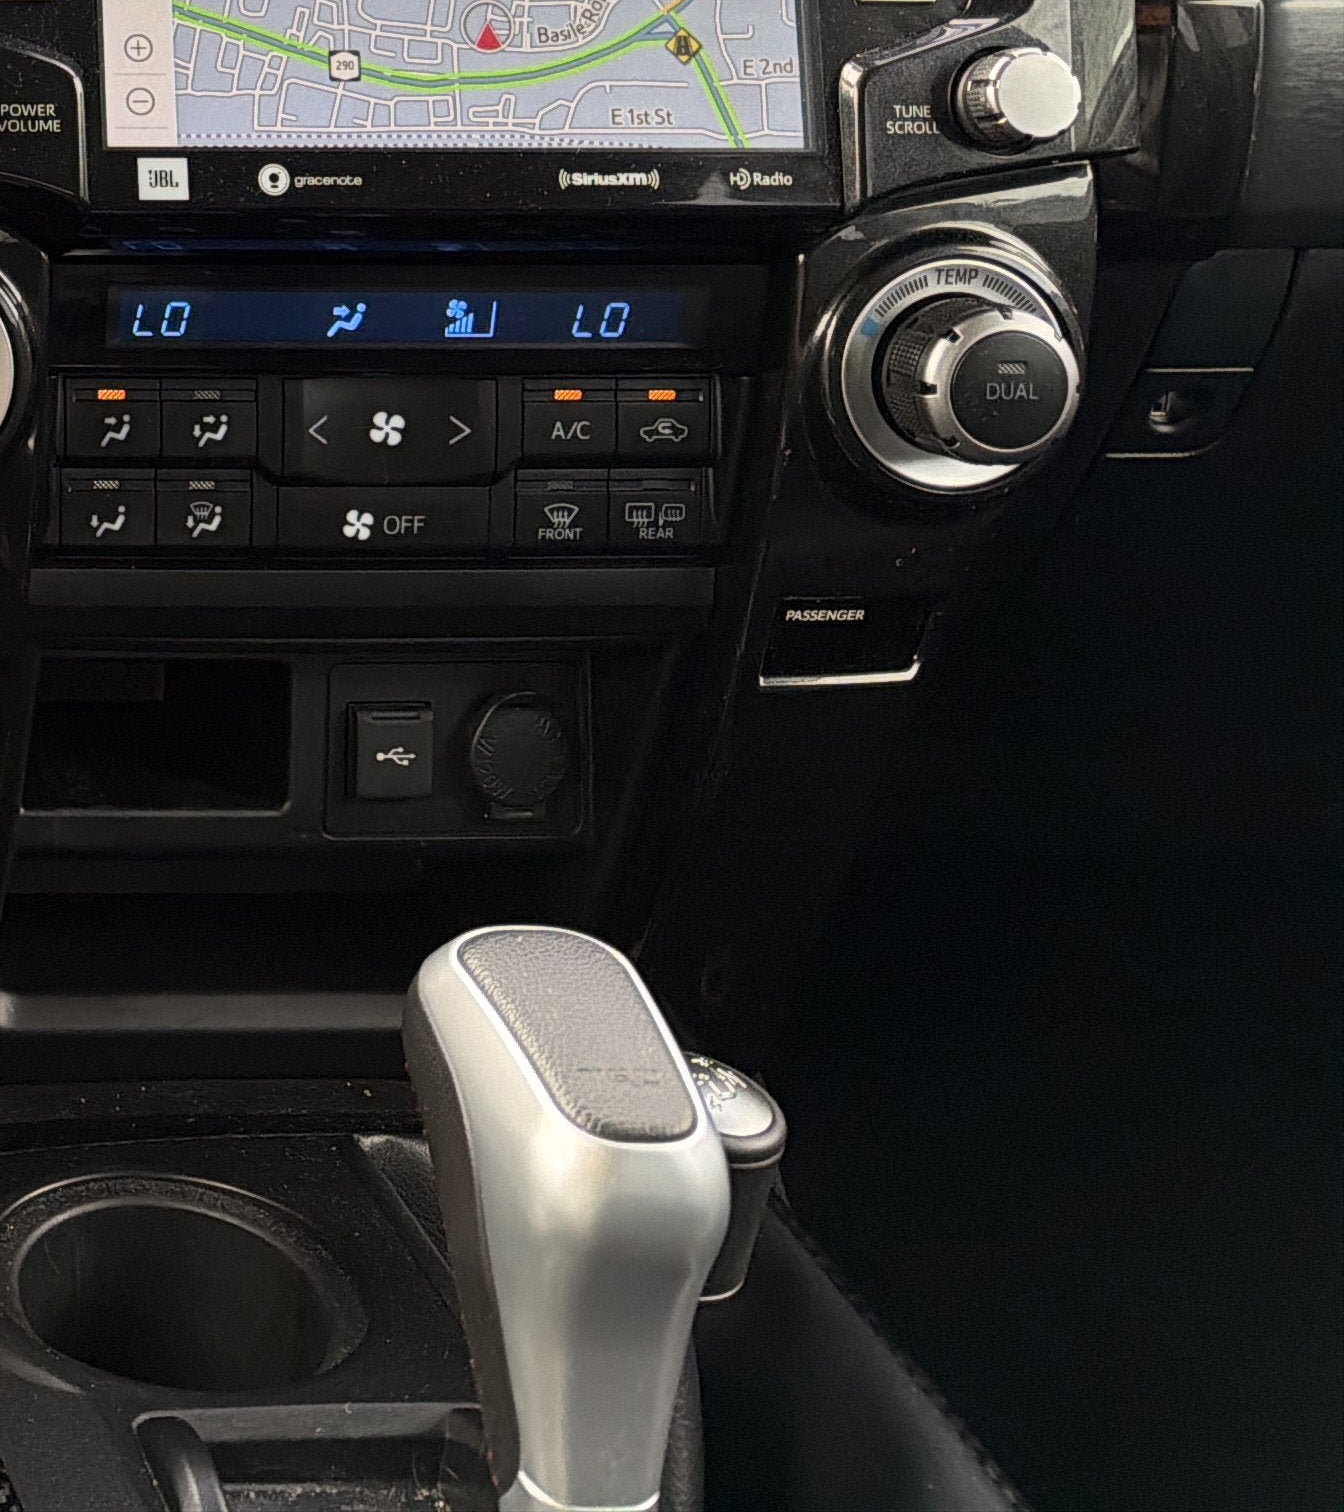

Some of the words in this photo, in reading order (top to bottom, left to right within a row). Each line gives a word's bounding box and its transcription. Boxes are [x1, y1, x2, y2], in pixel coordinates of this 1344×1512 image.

[335, 58, 355, 72] 290
[743, 58, 753, 75] E
[759, 56, 794, 76] 2nd
[0, 103, 56, 118] POWER
[611, 109, 621, 125] E
[624, 108, 650, 126] 1st
[655, 109, 674, 126] St
[893, 104, 931, 120] TUNE
[886, 120, 940, 135] SCROLL
[294, 174, 363, 188] gracenote
[753, 171, 793, 187] Radio
[934, 267, 980, 286] TEMP
[985, 381, 1039, 401] DUAL
[550, 420, 591, 442] A/C
[382, 514, 426, 536] OFF
[638, 526, 674, 540] REAR
[537, 526, 583, 541] FRONT
[785, 609, 865, 622] PASSENGER
